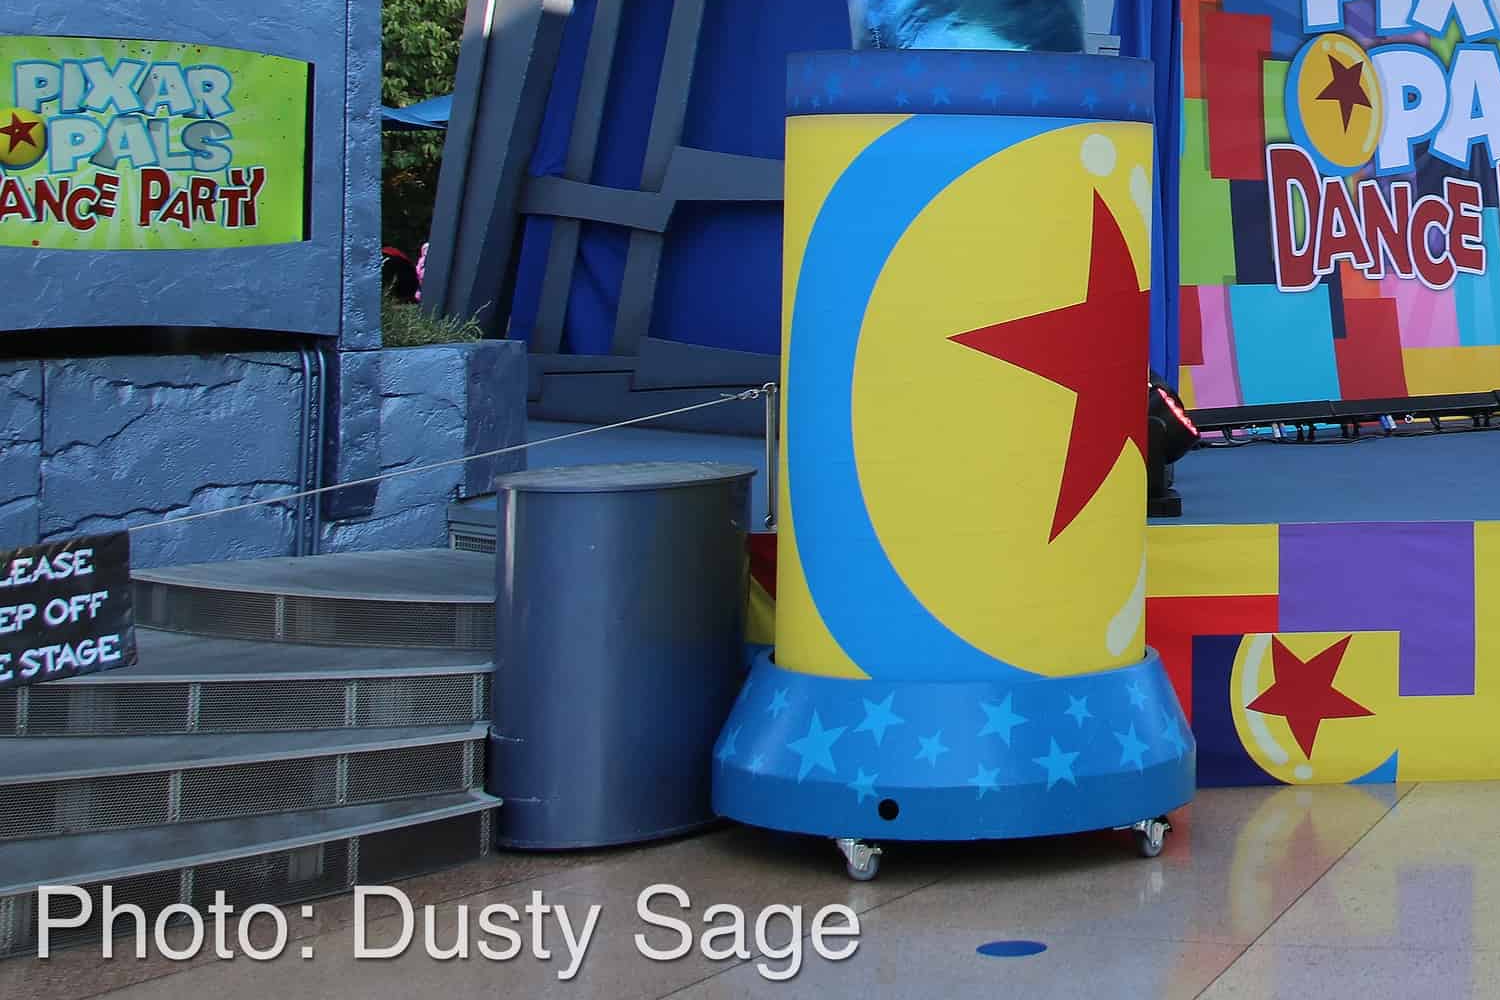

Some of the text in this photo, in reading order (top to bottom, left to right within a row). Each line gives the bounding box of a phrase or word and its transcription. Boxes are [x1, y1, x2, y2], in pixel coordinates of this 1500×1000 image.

[13, 56, 233, 118] PIXAR
[48, 112, 233, 174] PALS
[0, 166, 265, 232] ANCE PARTY
[1265, 143, 1487, 292] DANCE
[44, 590, 109, 625] OFF
[20, 634, 121, 677] STAGE
